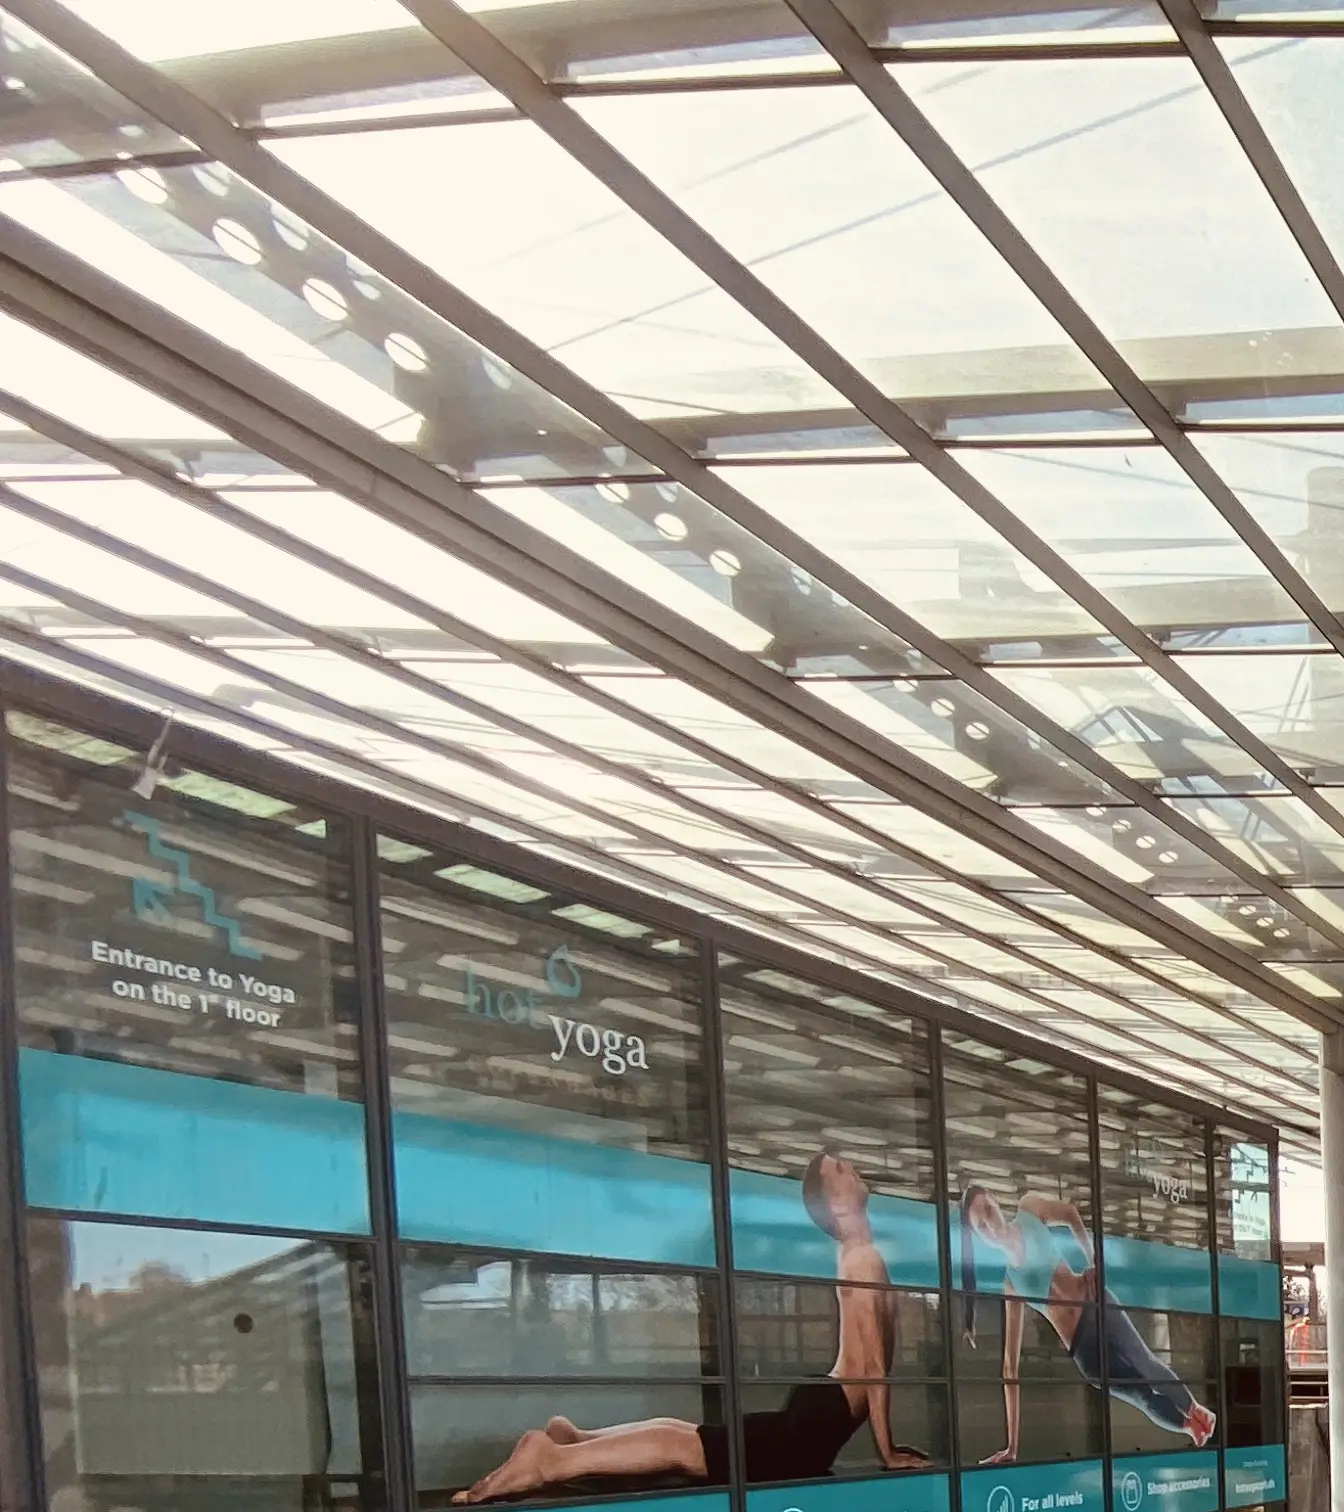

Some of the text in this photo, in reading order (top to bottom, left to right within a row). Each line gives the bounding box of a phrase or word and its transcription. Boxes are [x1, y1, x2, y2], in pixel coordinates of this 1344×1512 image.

[91, 940, 296, 1004] Entrance to Yoga
[112, 979, 145, 1000] on
[151, 984, 192, 1010] the
[225, 999, 281, 1028] floor
[547, 1014, 649, 1075] yoga
[1152, 1173, 1189, 1204] yoga
[1021, 1490, 1084, 1512] For all levels
